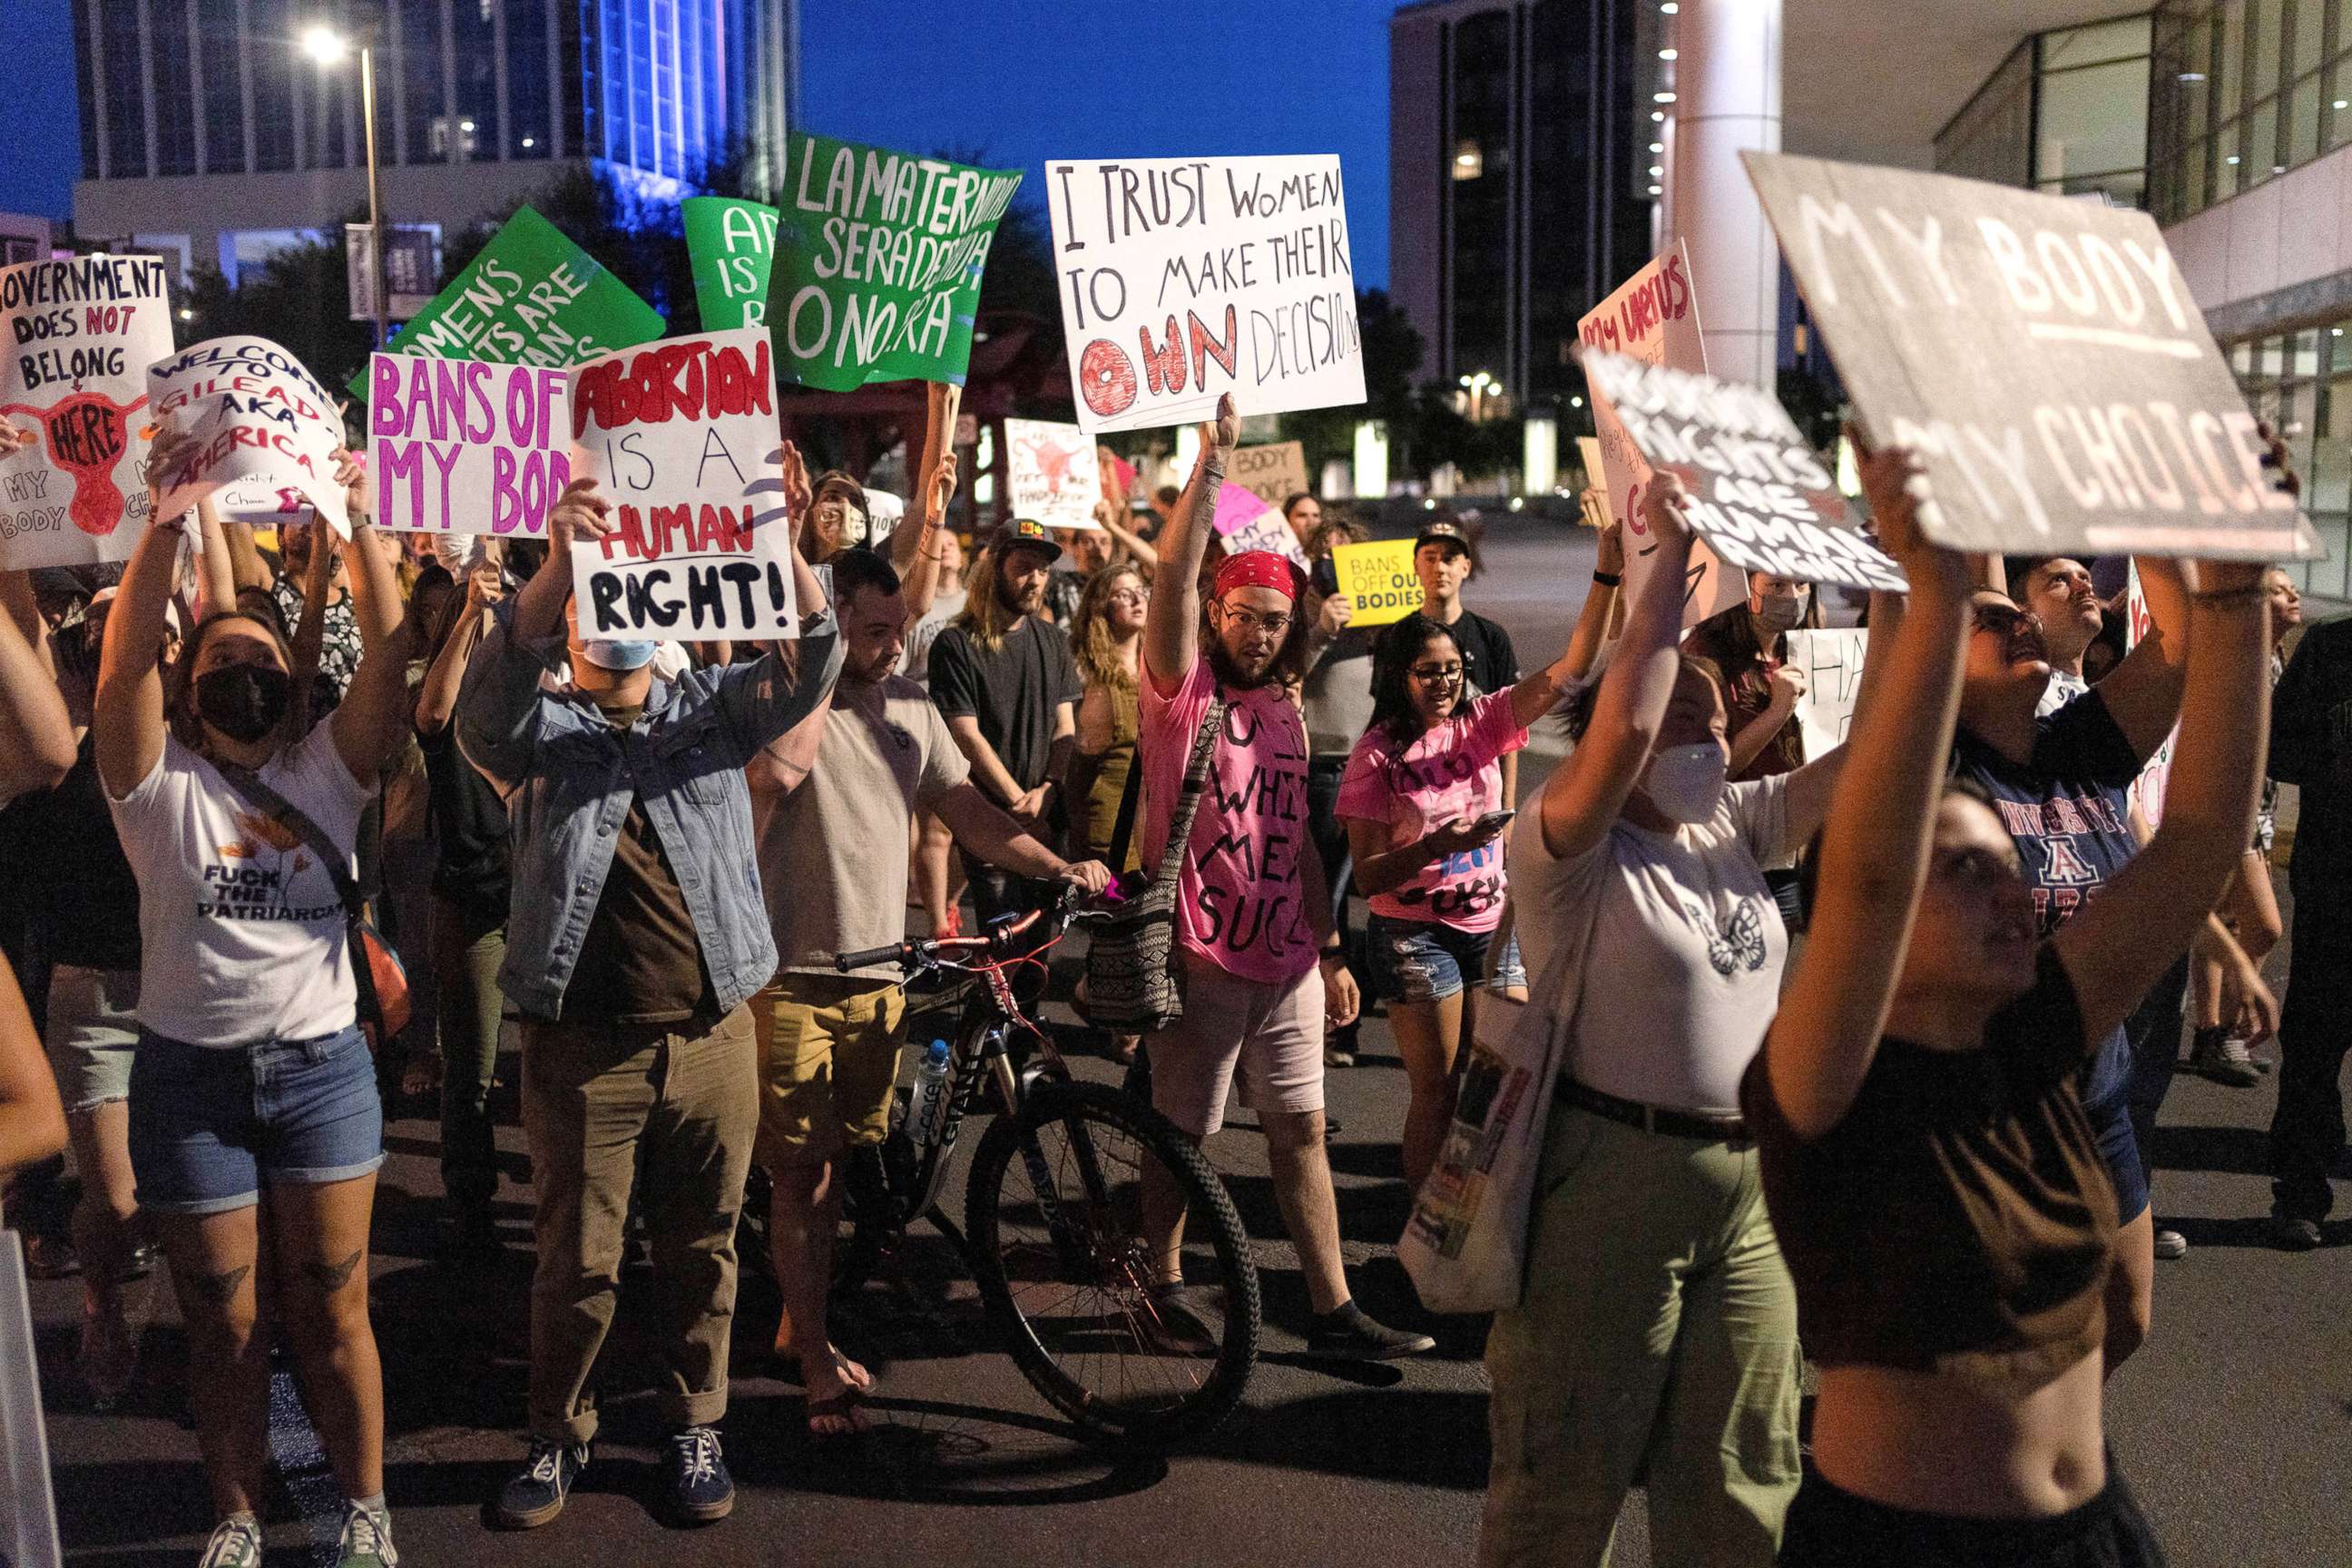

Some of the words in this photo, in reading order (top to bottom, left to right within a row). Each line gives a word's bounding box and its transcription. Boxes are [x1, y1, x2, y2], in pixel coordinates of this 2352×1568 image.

[1056, 166, 1085, 252] I
[1099, 163, 1210, 244] TRUST
[1226, 168, 1340, 218] WOMEN
[0, 259, 164, 315] OVERNMENT
[717, 257, 759, 298] IS
[1066, 267, 1126, 329] TO
[1158, 243, 1257, 308] MAKE
[1267, 218, 1350, 285] THEIR
[1798, 191, 1958, 308] MY
[1976, 216, 2188, 329] BODY
[12, 308, 78, 345] DOES
[86, 305, 136, 336] NOT
[514, 261, 589, 333] ARE
[788, 285, 833, 358] O
[19, 347, 125, 391] BELONG
[207, 360, 272, 377] TO
[1080, 303, 1237, 417] OWN
[158, 377, 320, 420] GILEAD
[216, 393, 299, 434] AKA
[373, 354, 495, 445] BANS
[573, 338, 772, 440] ABORTION
[50, 403, 120, 466] HERE
[168, 425, 317, 497] AMERICA
[606, 431, 654, 491] IS
[696, 426, 747, 489] A
[2034, 400, 2297, 515] CHOICE
[3, 469, 48, 503] MY
[378, 439, 464, 530] MY
[0, 505, 66, 539] BODY
[599, 502, 754, 562] HUMAN
[1232, 522, 1260, 546] MY
[1350, 555, 1400, 575] BANS
[1352, 573, 1388, 593] OFF
[1391, 573, 1423, 589] OU
[1710, 534, 1910, 593] RIGHTS
[589, 560, 788, 632] RIGHT!
[1357, 590, 1425, 611] BODIES
[203, 865, 281, 887] FUCK
[2039, 835, 2101, 886] A
[214, 884, 268, 903] THE
